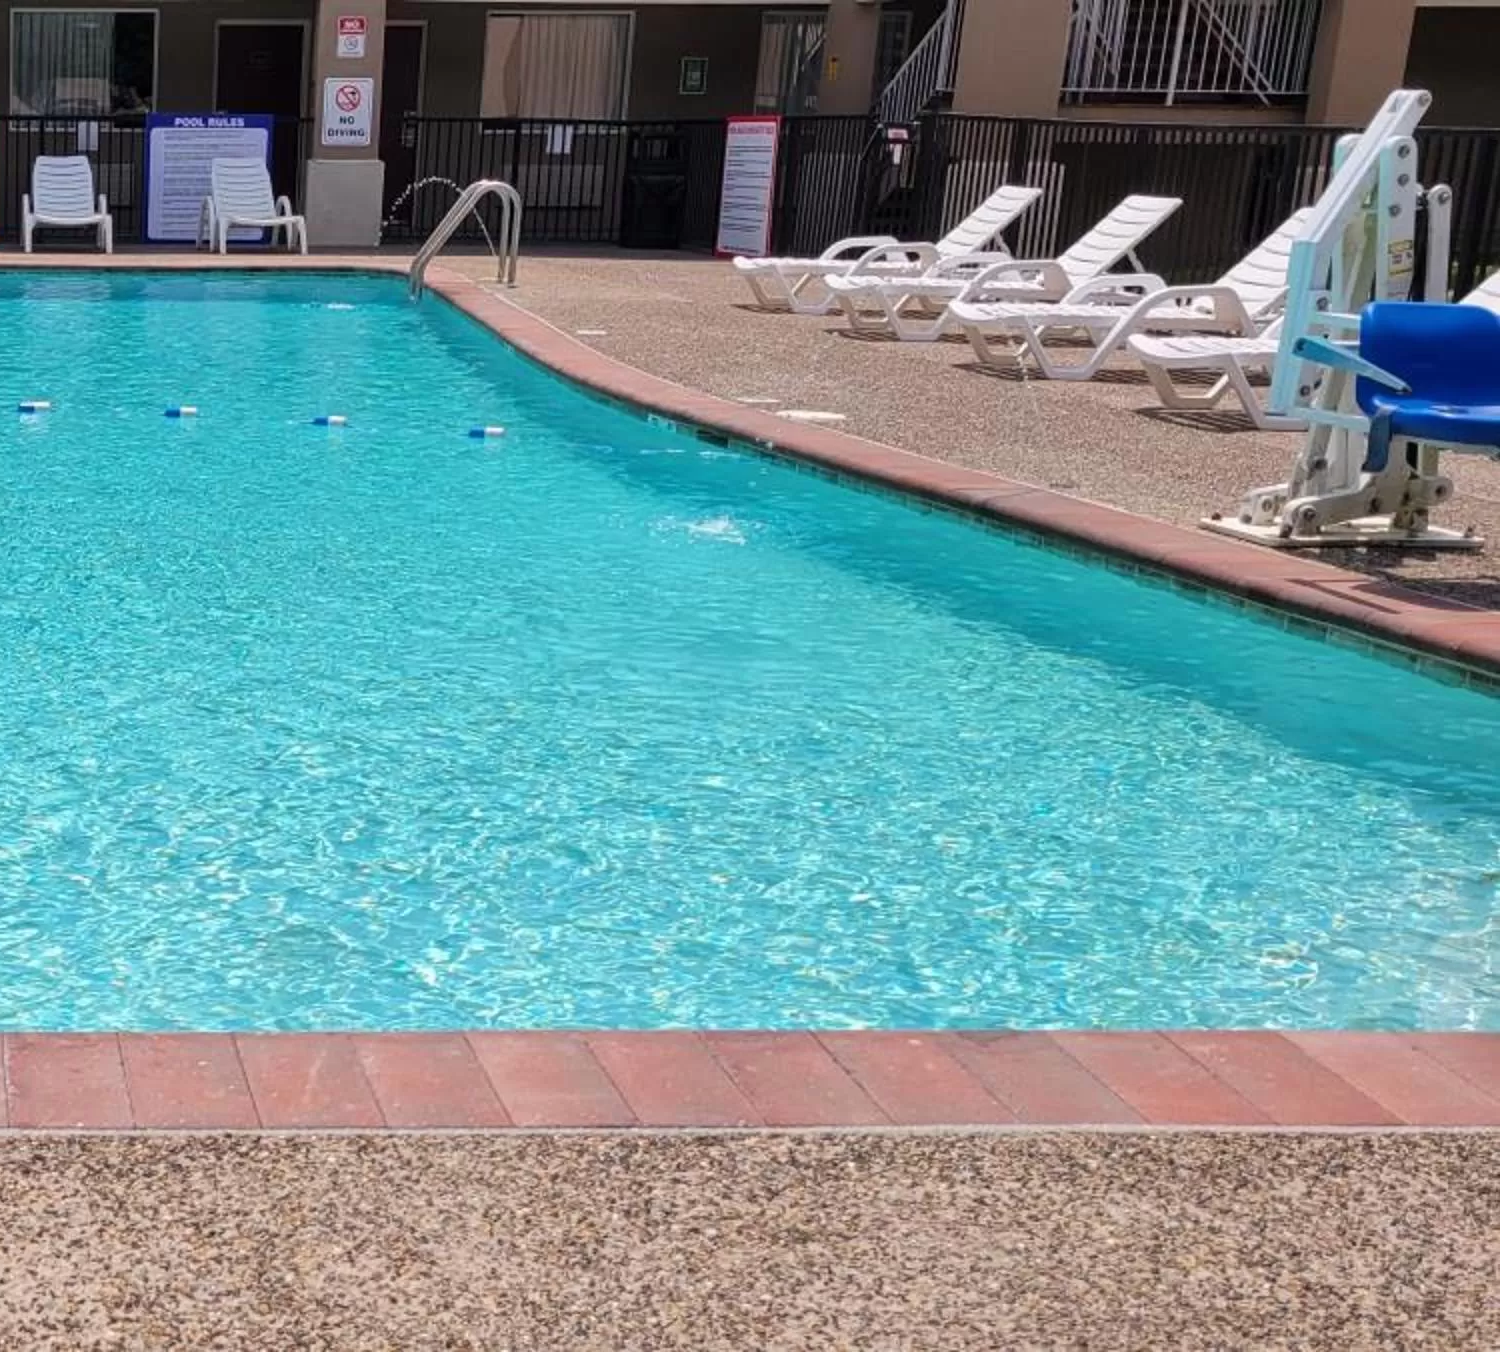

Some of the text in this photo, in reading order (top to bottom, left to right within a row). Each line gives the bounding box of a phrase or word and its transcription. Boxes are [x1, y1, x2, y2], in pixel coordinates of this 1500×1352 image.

[175, 117, 244, 127] POOL RULES
[339, 116, 355, 124] NO
[328, 128, 365, 137] DIVING
